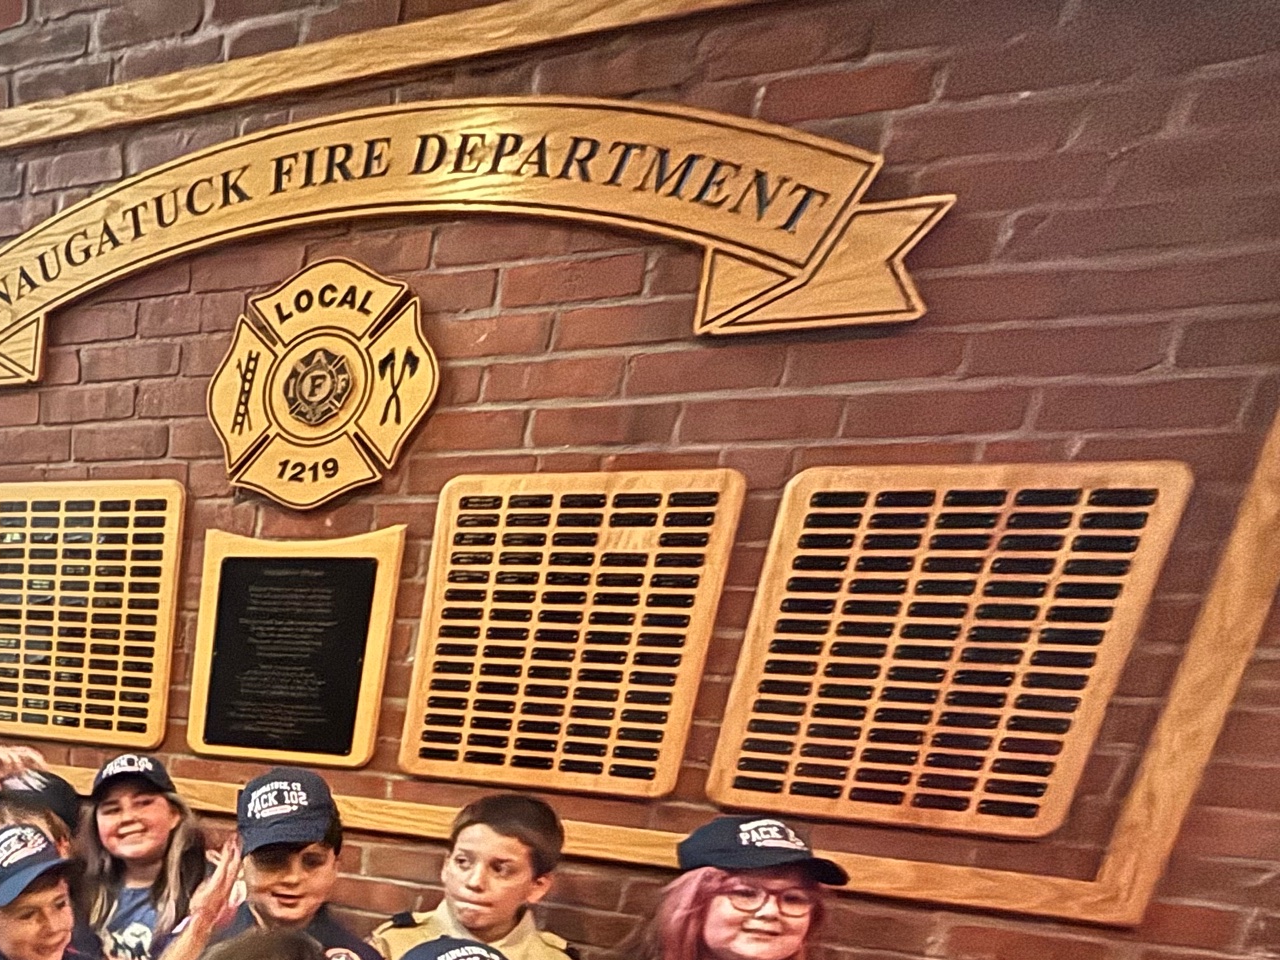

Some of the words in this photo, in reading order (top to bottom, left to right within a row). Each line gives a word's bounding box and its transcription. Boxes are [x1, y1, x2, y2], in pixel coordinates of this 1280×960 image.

[269, 137, 393, 195] FIRE
[407, 133, 831, 234] DEPARTMENT
[274, 283, 374, 325] LOCAL
[307, 374, 327, 398] F
[276, 457, 340, 483] 1219
[247, 790, 279, 818] PACK
[283, 790, 309, 806] 102
[739, 826, 784, 845] PACK
